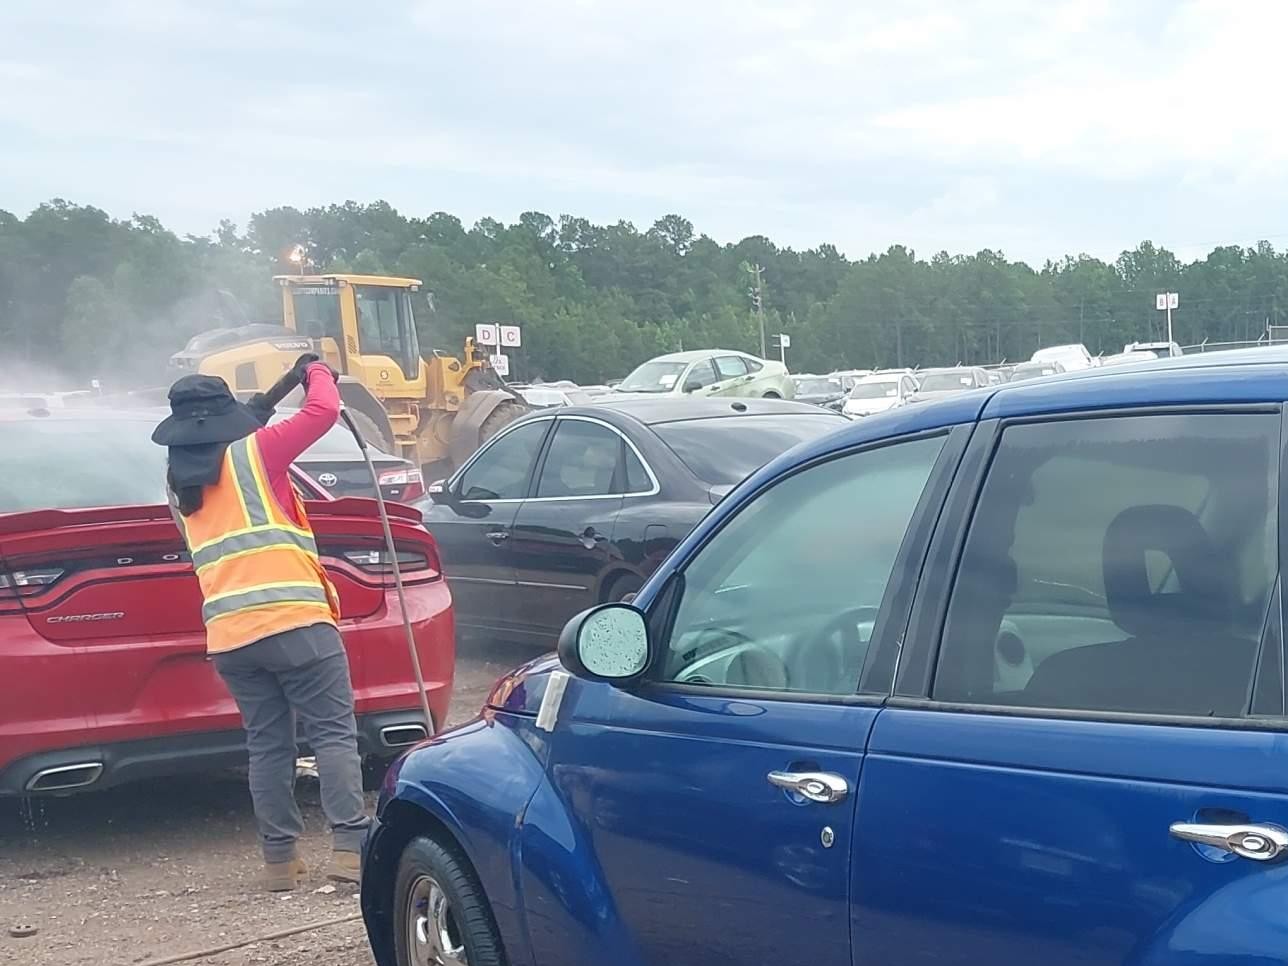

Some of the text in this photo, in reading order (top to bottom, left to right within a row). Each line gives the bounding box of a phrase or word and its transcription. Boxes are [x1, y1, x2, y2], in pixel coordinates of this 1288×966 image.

[482, 330, 491, 340] D
[507, 331, 516, 342] C
[46, 611, 125, 624] CHARGER
